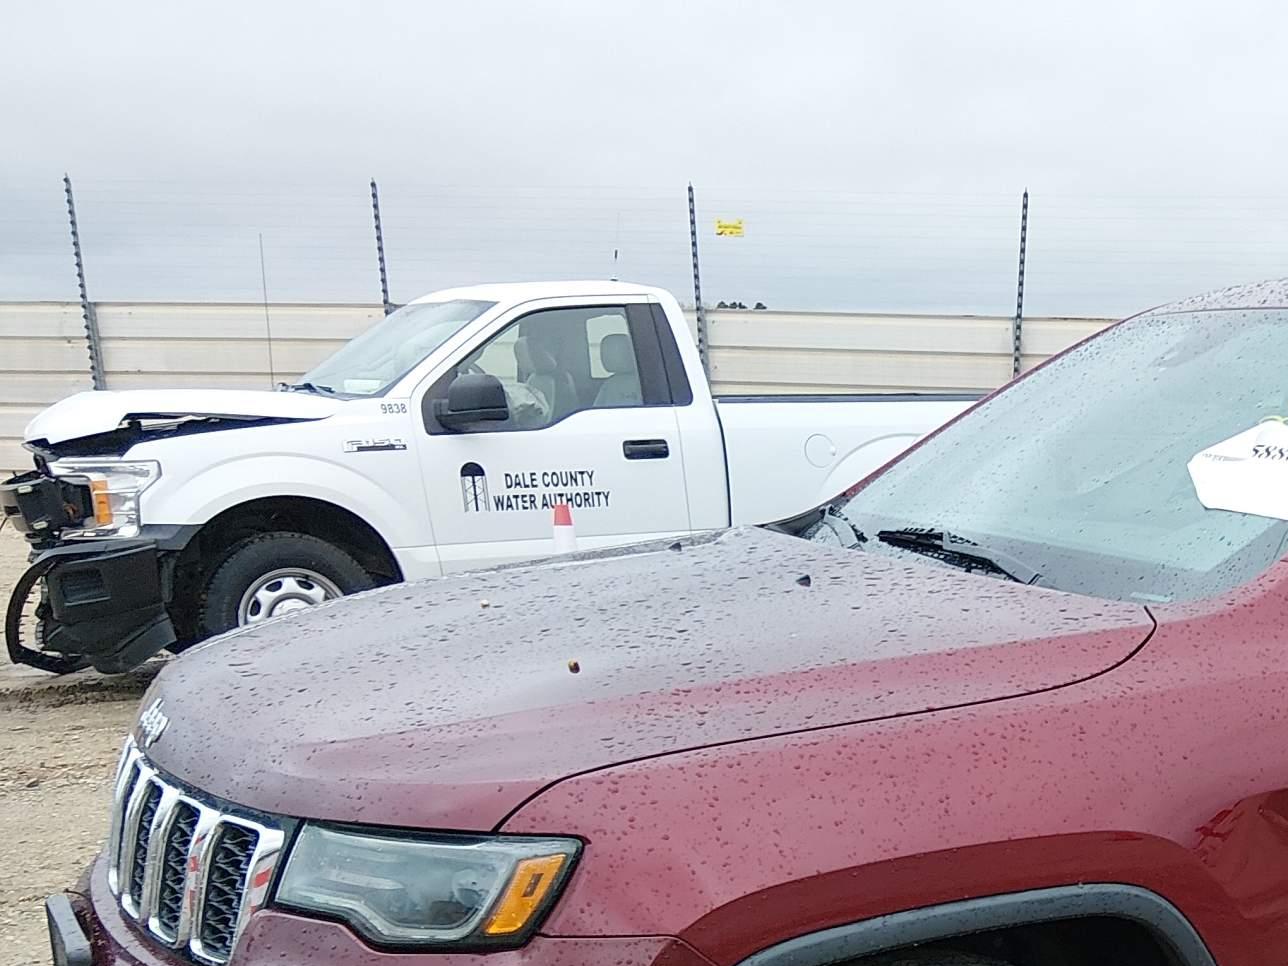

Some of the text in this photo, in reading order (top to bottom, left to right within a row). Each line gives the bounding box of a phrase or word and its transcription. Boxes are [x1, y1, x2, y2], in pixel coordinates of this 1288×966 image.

[380, 403, 407, 414] 9838
[504, 470, 595, 489] DALE COUNTY
[493, 491, 610, 511] WATER AUTHORITY
